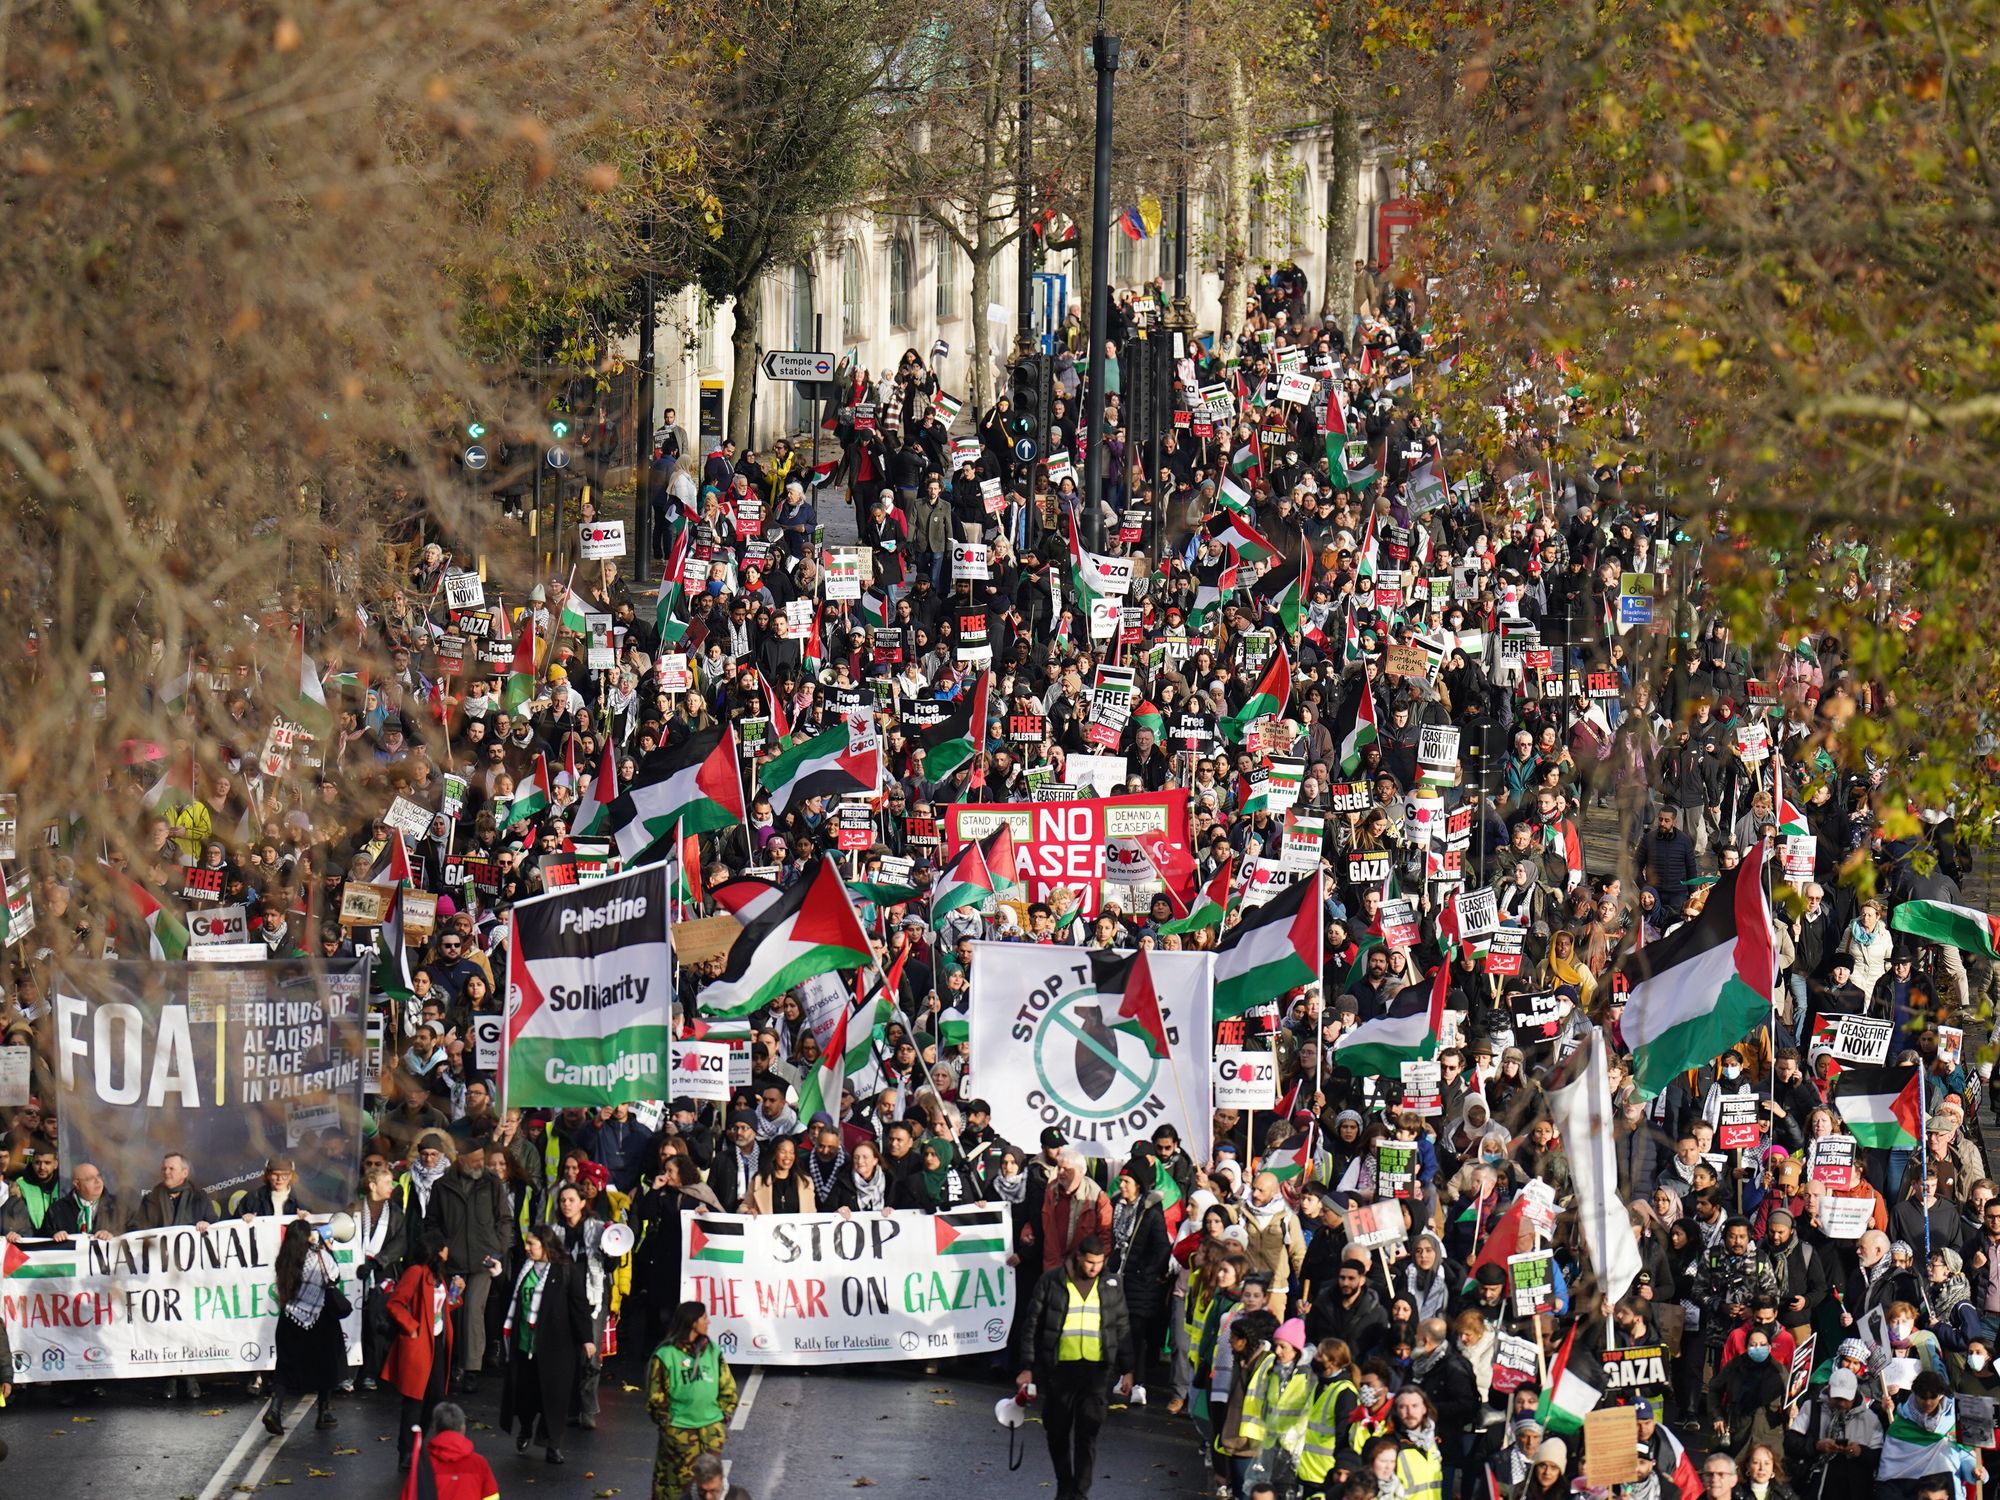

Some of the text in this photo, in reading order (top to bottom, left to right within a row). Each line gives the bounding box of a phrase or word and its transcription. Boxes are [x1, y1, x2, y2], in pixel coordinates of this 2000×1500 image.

[780, 356, 812, 369] Temple
[1261, 431, 1286, 444] GAZA
[581, 527, 622, 541] Gza
[954, 550, 984, 563] Gza
[447, 577, 479, 591] CEASEFIRE
[453, 589, 481, 603] NOW!
[460, 616, 492, 636] GAZA
[960, 613, 986, 632] FREE
[876, 632, 898, 640] FREEDOM
[1398, 649, 1417, 658] STOP
[1588, 673, 1618, 688] FREE
[837, 692, 859, 703] Free
[1094, 690, 1129, 706] FREE
[914, 703, 939, 714] Free
[1010, 716, 1042, 732] FREE
[1168, 726, 1213, 740] Palestine
[851, 739, 874, 752] Gza
[1422, 731, 1457, 745] CEASEFIRE
[1423, 744, 1452, 760] NOW!
[1251, 769, 1269, 783] CEASE
[1036, 788, 1076, 801] CEASEFIRE
[1334, 793, 1369, 810] SIEGE
[1405, 804, 1442, 822] Gza
[1448, 811, 1471, 832] FREE
[971, 826, 1017, 837] HUMAY
[1039, 808, 1092, 842] NO
[1107, 844, 1147, 864] Gza
[186, 869, 223, 889] FREE
[468, 863, 498, 883] FREE
[547, 865, 576, 883] FREE
[1350, 863, 1389, 881] GAZA
[1459, 896, 1495, 914] CEASEFIRE
[559, 896, 647, 934] Palestine
[1466, 910, 1496, 930] NOW!
[193, 918, 243, 936] Gza
[550, 975, 650, 1012] Solidarity
[244, 993, 351, 1027] FRIENDS OF
[1013, 974, 1062, 1043] STOP
[813, 1018, 835, 1036] NEVER
[1218, 1024, 1244, 1044] FREE
[1841, 1024, 1888, 1040] CEASEFIRE
[244, 1024, 323, 1053] AL-AQSA
[1843, 1038, 1884, 1056] NOW!
[57, 996, 200, 1108] FOA
[244, 1051, 302, 1078] PEACE
[545, 1051, 657, 1091] Campaign
[1219, 1059, 1273, 1083] Gza
[243, 1058, 359, 1103] IN PALESTINE
[680, 1077, 724, 1086] the massacre
[1026, 1090, 1166, 1141] COALITION
[1724, 1103, 1755, 1112] FREEDOM
[1722, 1113, 1756, 1124] PALESTINE
[201, 1170, 265, 1194] RIENDSOFALAQSA
[773, 1219, 900, 1263] STOP
[89, 1226, 268, 1276] NATIONAL
[690, 1266, 1005, 1319] THE WAR ON GAZA!
[3, 1278, 353, 1329] MARCH FOR PALESE
[795, 1335, 890, 1350] Rally For Palestine
[928, 1334, 948, 1347] FOA
[131, 1349, 158, 1363] Rally
[182, 1346, 230, 1360] Palestine
[1604, 1358, 1666, 1387] GAZA
